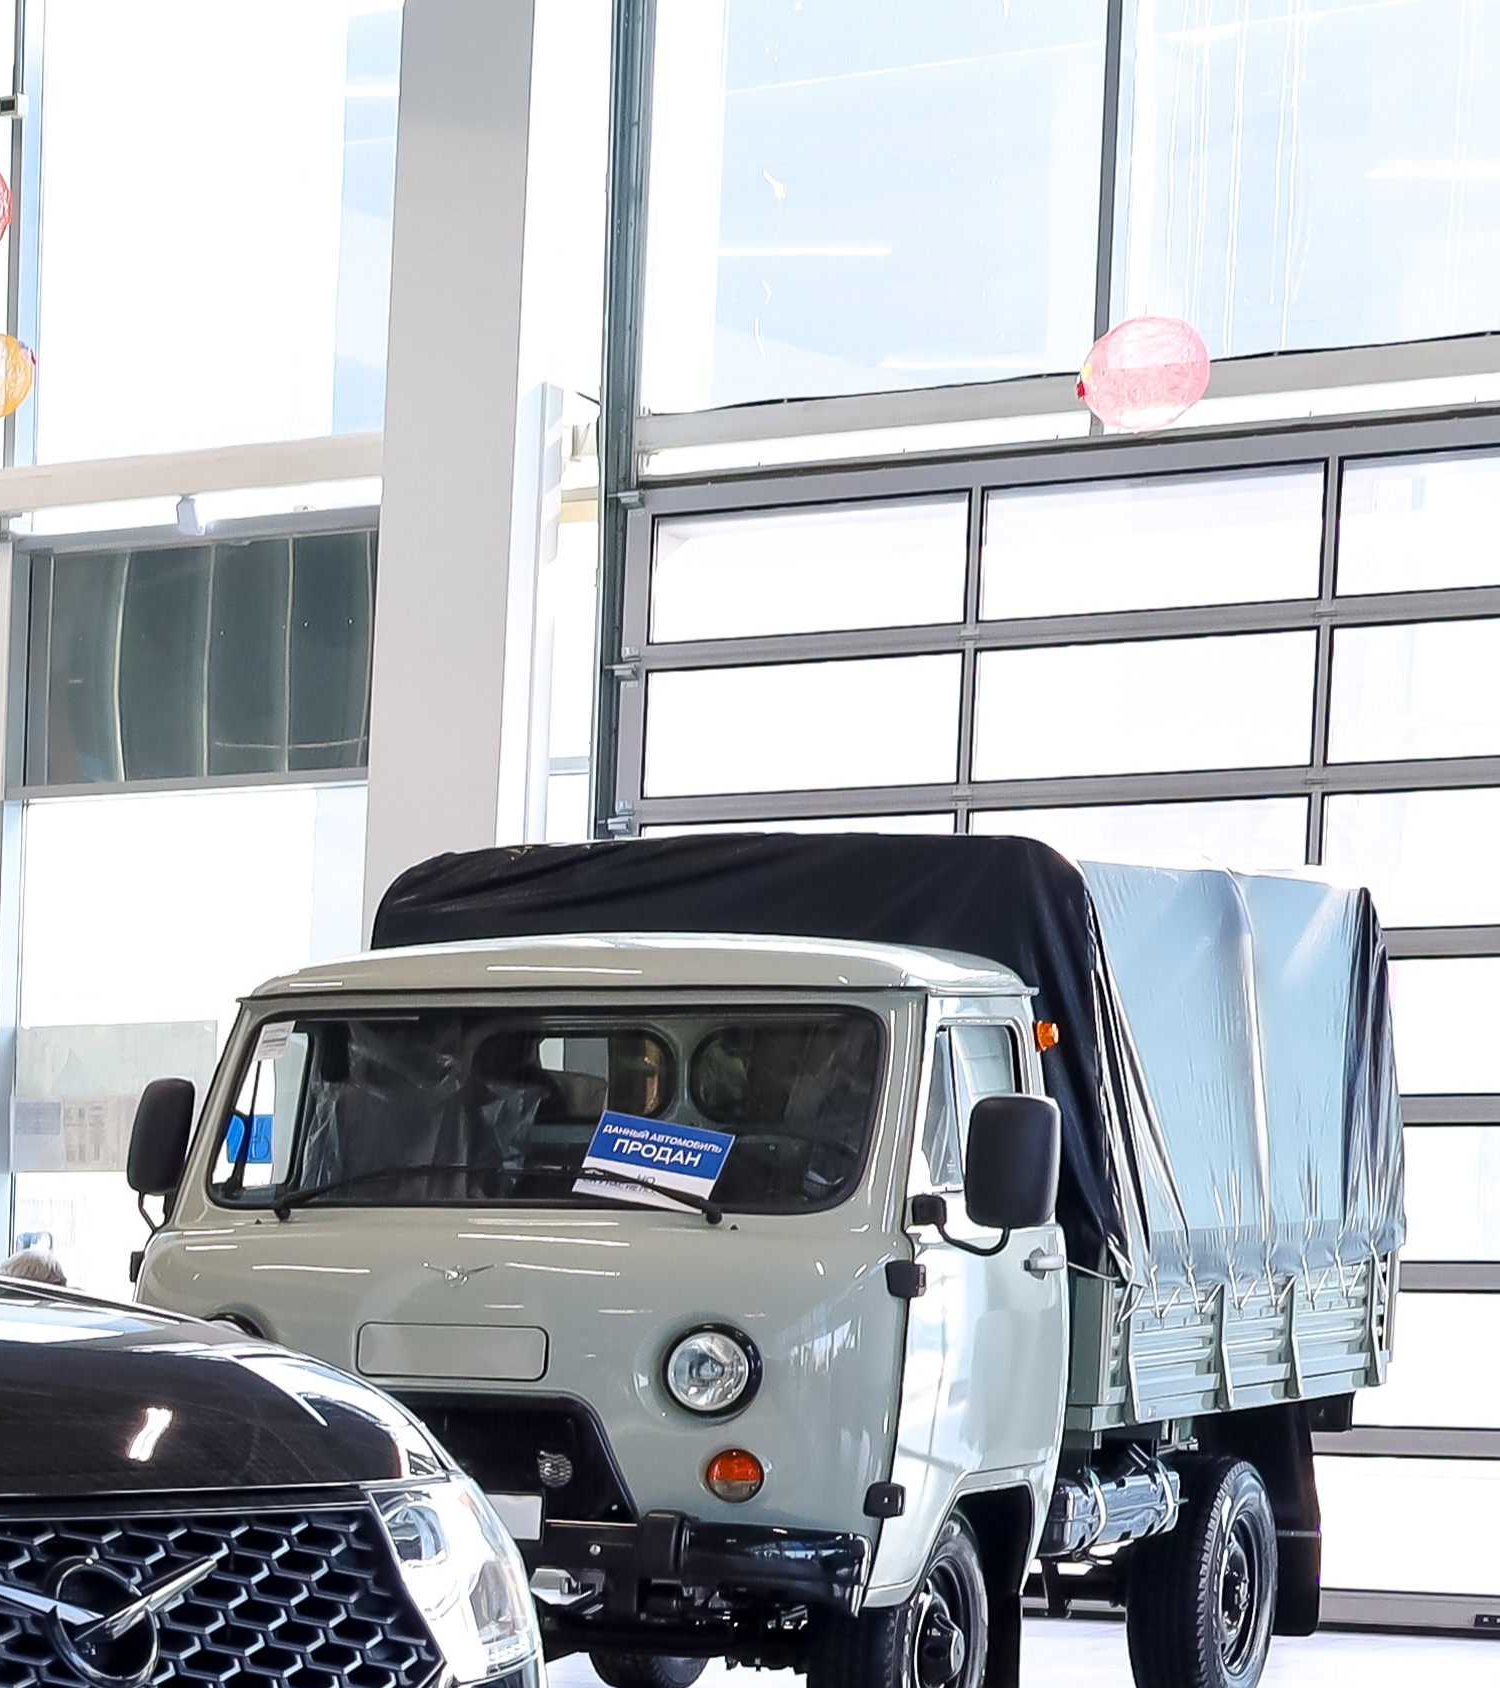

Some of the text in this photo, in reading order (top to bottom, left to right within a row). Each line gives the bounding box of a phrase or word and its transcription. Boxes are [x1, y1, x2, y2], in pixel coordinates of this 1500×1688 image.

[602, 1123, 723, 1154] ДАННЫЙ АВТОМОБИЛЬ
[612, 1138, 702, 1168] ПРОДАН
